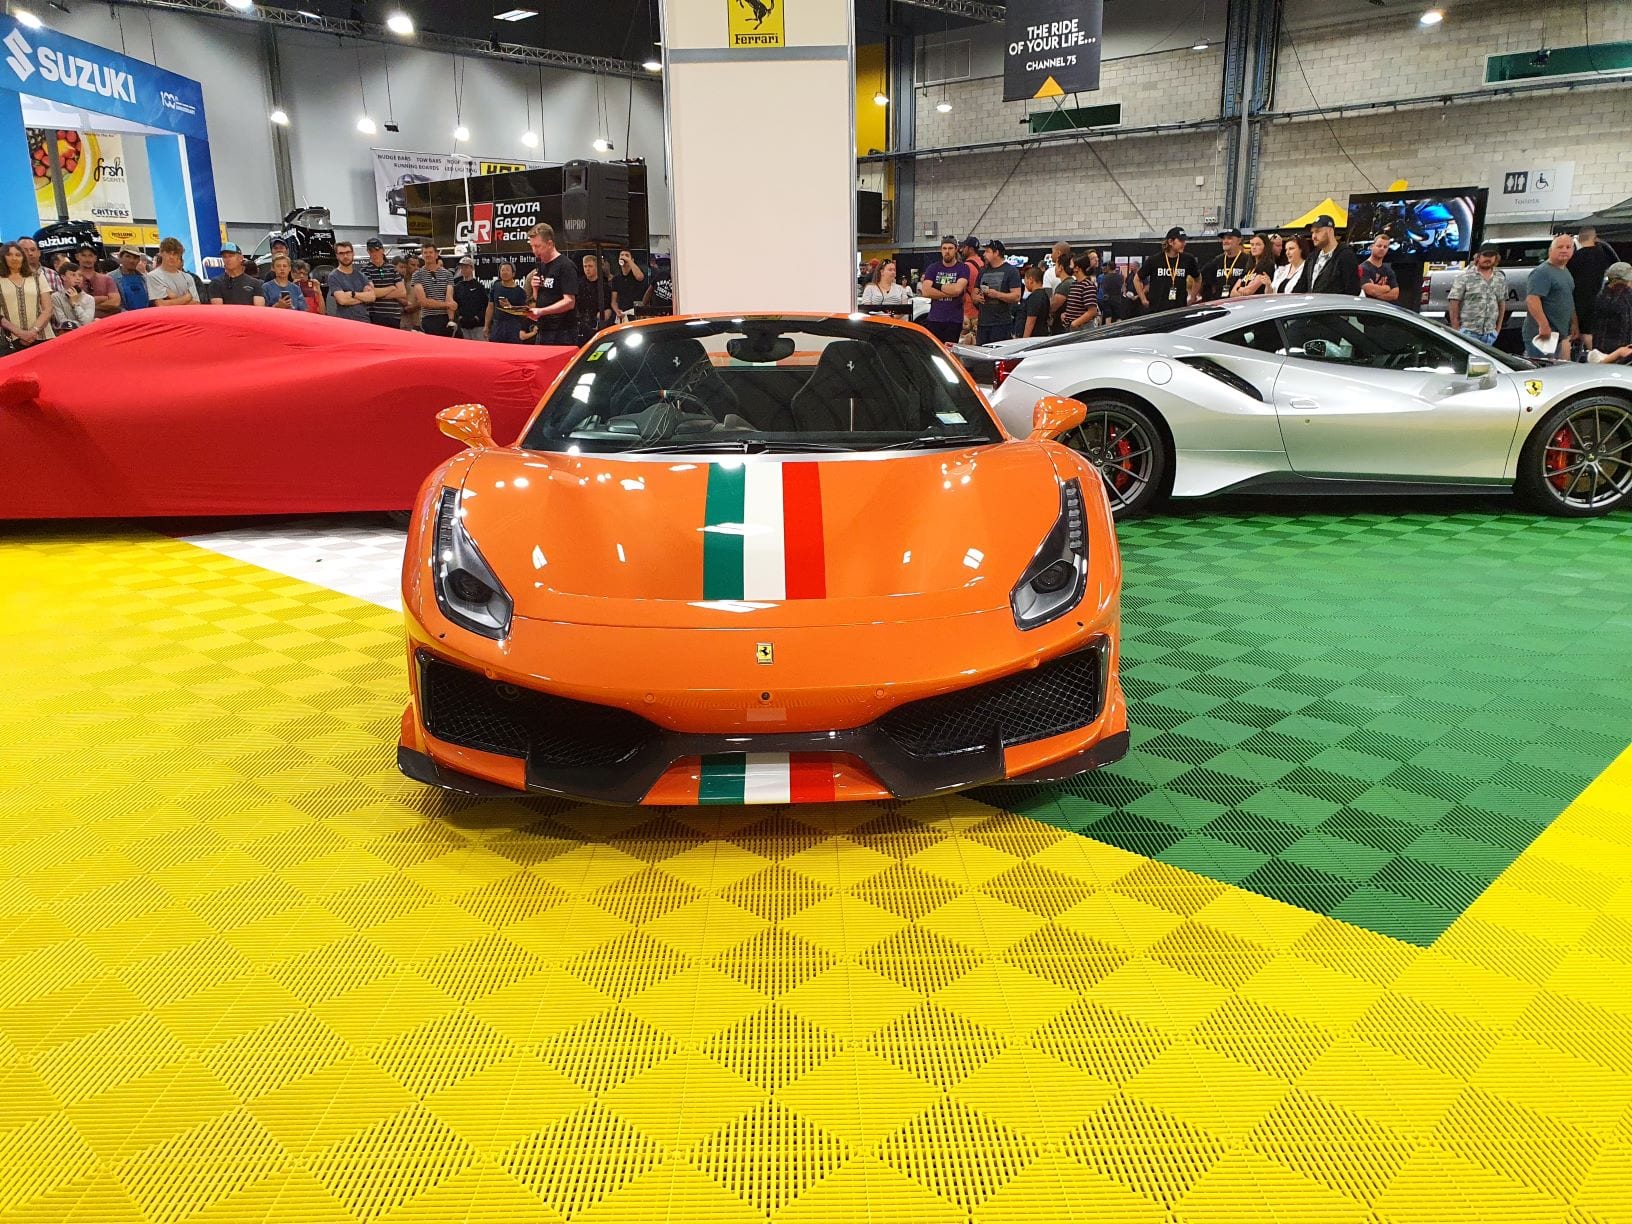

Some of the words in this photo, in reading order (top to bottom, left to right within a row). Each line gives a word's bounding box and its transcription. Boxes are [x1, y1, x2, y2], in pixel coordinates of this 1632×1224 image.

[1027, 24, 1050, 39] THE
[1051, 18, 1079, 36] RIDE
[735, 33, 779, 45] Ferrari
[1009, 41, 1025, 55] OF
[1026, 36, 1060, 53] YOUR
[1061, 31, 1096, 48] LIFE...
[1026, 57, 1066, 71] CHANNEL
[1066, 55, 1077, 66] 75
[37, 46, 137, 104] SUZUKI
[91, 208, 130, 217] CRITTERS
[495, 201, 541, 216] TOYOTA
[495, 216, 536, 228] GAZOO
[565, 219, 586, 230] MIPRO
[456, 219, 492, 242] GR
[495, 228, 531, 243] Racin
[38, 236, 77, 248] SUZUKI
[509, 255, 518, 263] for
